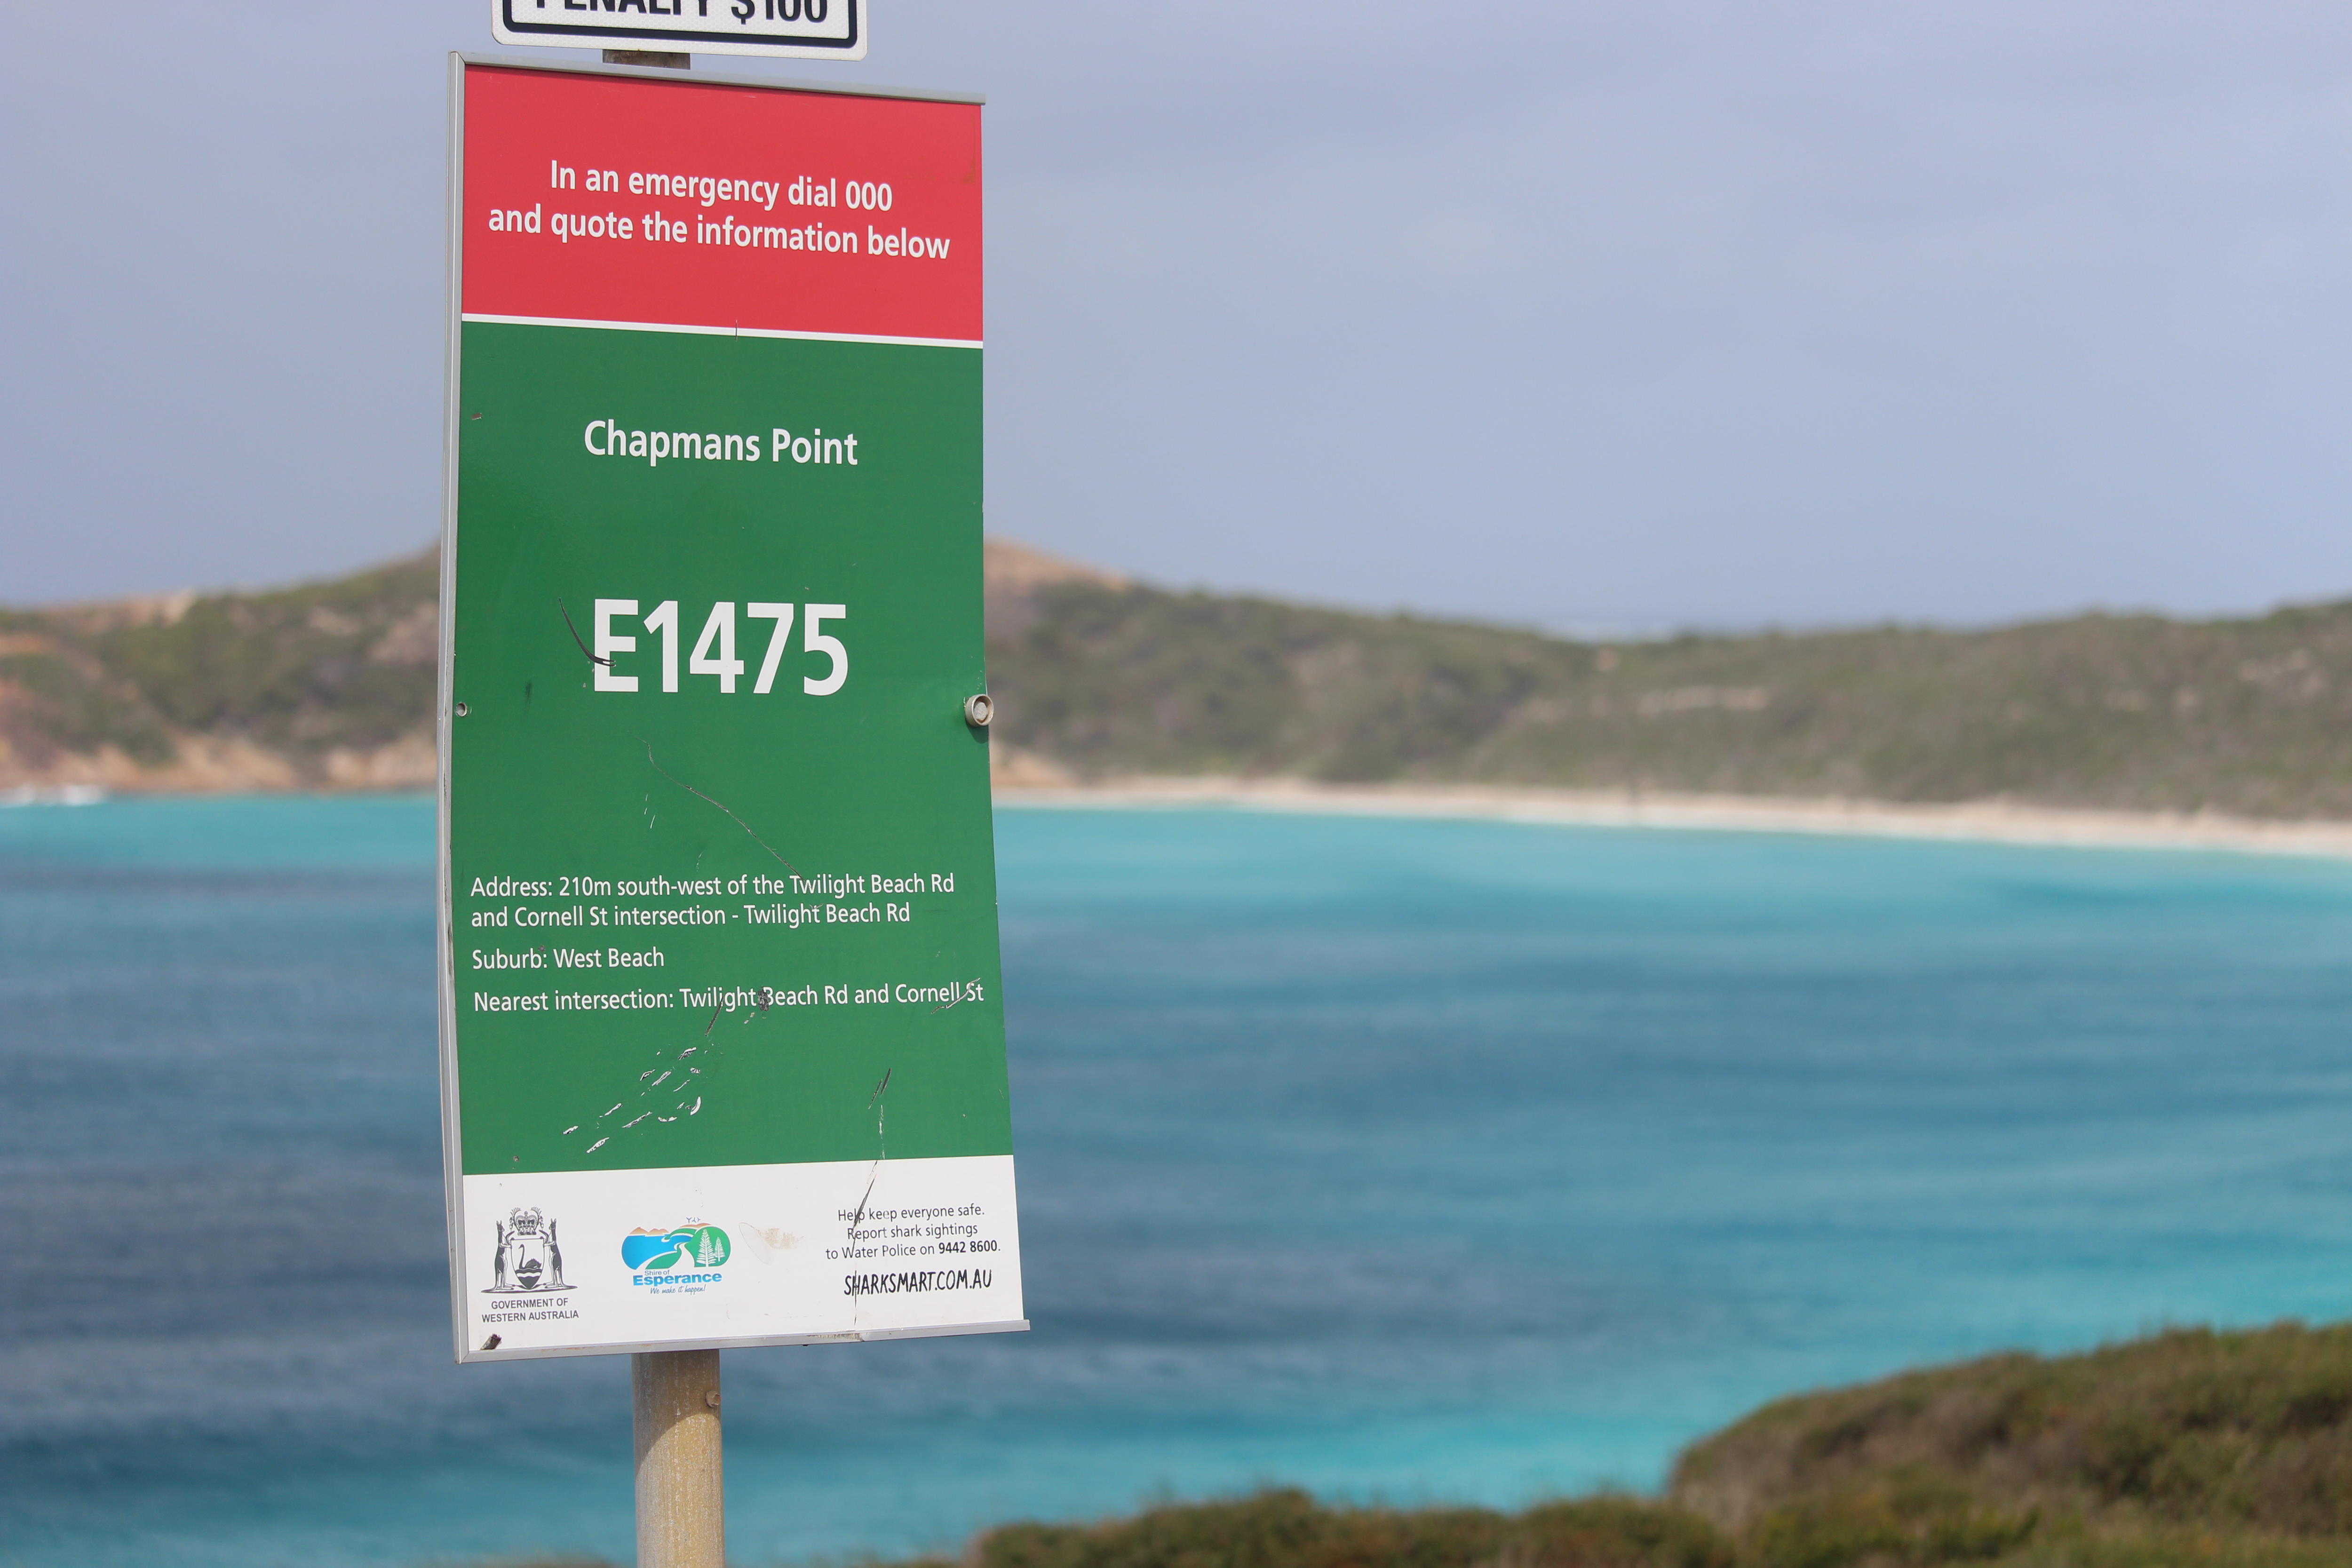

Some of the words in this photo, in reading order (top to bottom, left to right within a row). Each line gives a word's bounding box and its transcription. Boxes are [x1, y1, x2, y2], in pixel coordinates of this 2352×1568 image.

[550, 159, 576, 191] In
[585, 167, 619, 193] an
[628, 172, 779, 210] emergency
[788, 174, 837, 209] dial
[845, 180, 893, 212] 000
[488, 204, 542, 235] and
[550, 210, 634, 244] quote
[642, 211, 688, 243] the
[697, 214, 858, 254] information
[867, 225, 951, 260] below
[584, 419, 760, 467] Chapmans
[772, 428, 858, 465] Point
[594, 598, 848, 696] E1475
[470, 876, 553, 897] Address:
[558, 875, 612, 896] 210m
[617, 874, 721, 895] south-west
[727, 872, 750, 895] of
[754, 873, 785, 894] the
[789, 874, 866, 898] Twilight
[870, 873, 927, 892] Beach
[931, 871, 955, 892] Rd
[471, 906, 510, 927] and
[514, 905, 584, 927] Cornell
[589, 904, 609, 926] St
[613, 903, 726, 925] intersection
[744, 903, 821, 926] Twilight
[826, 903, 882, 923] Beach
[886, 901, 911, 922] Rd
[471, 947, 548, 969] Suburb:
[553, 947, 603, 968] West
[607, 946, 665, 967] Beach
[474, 990, 549, 1011] Nearest
[555, 988, 674, 1009] intersection:
[679, 985, 757, 1010] Twilight
[760, 985, 819, 1005] Beach
[824, 983, 849, 1004] Rd
[853, 983, 890, 1004] and
[894, 982, 962, 1003] Cornell
[966, 982, 985, 1001] St
[838, 1208, 866, 1222] Help
[869, 1207, 898, 1222] keep
[901, 1206, 954, 1220] everyone
[958, 1202, 985, 1217] safe.
[847, 1227, 888, 1242] Report
[890, 1224, 922, 1238] shark
[925, 1222, 978, 1239] sightings
[826, 1248, 838, 1259] to
[842, 1246, 878, 1258] Water
[882, 1244, 916, 1257] Police
[920, 1244, 935, 1255] on
[938, 1241, 966, 1254] 9442
[969, 1240, 1001, 1252] 8600.
[633, 1273, 723, 1287] Esperance
[684, 1284, 706, 1295] happen!
[844, 1268, 992, 1297] SHARKSMART.COM.AU
[482, 1313, 526, 1323] WESTERN
[528, 1309, 579, 1321] AUSTRALIA
[491, 1299, 554, 1310] GOVERNMENT
[556, 1298, 569, 1306] OF
